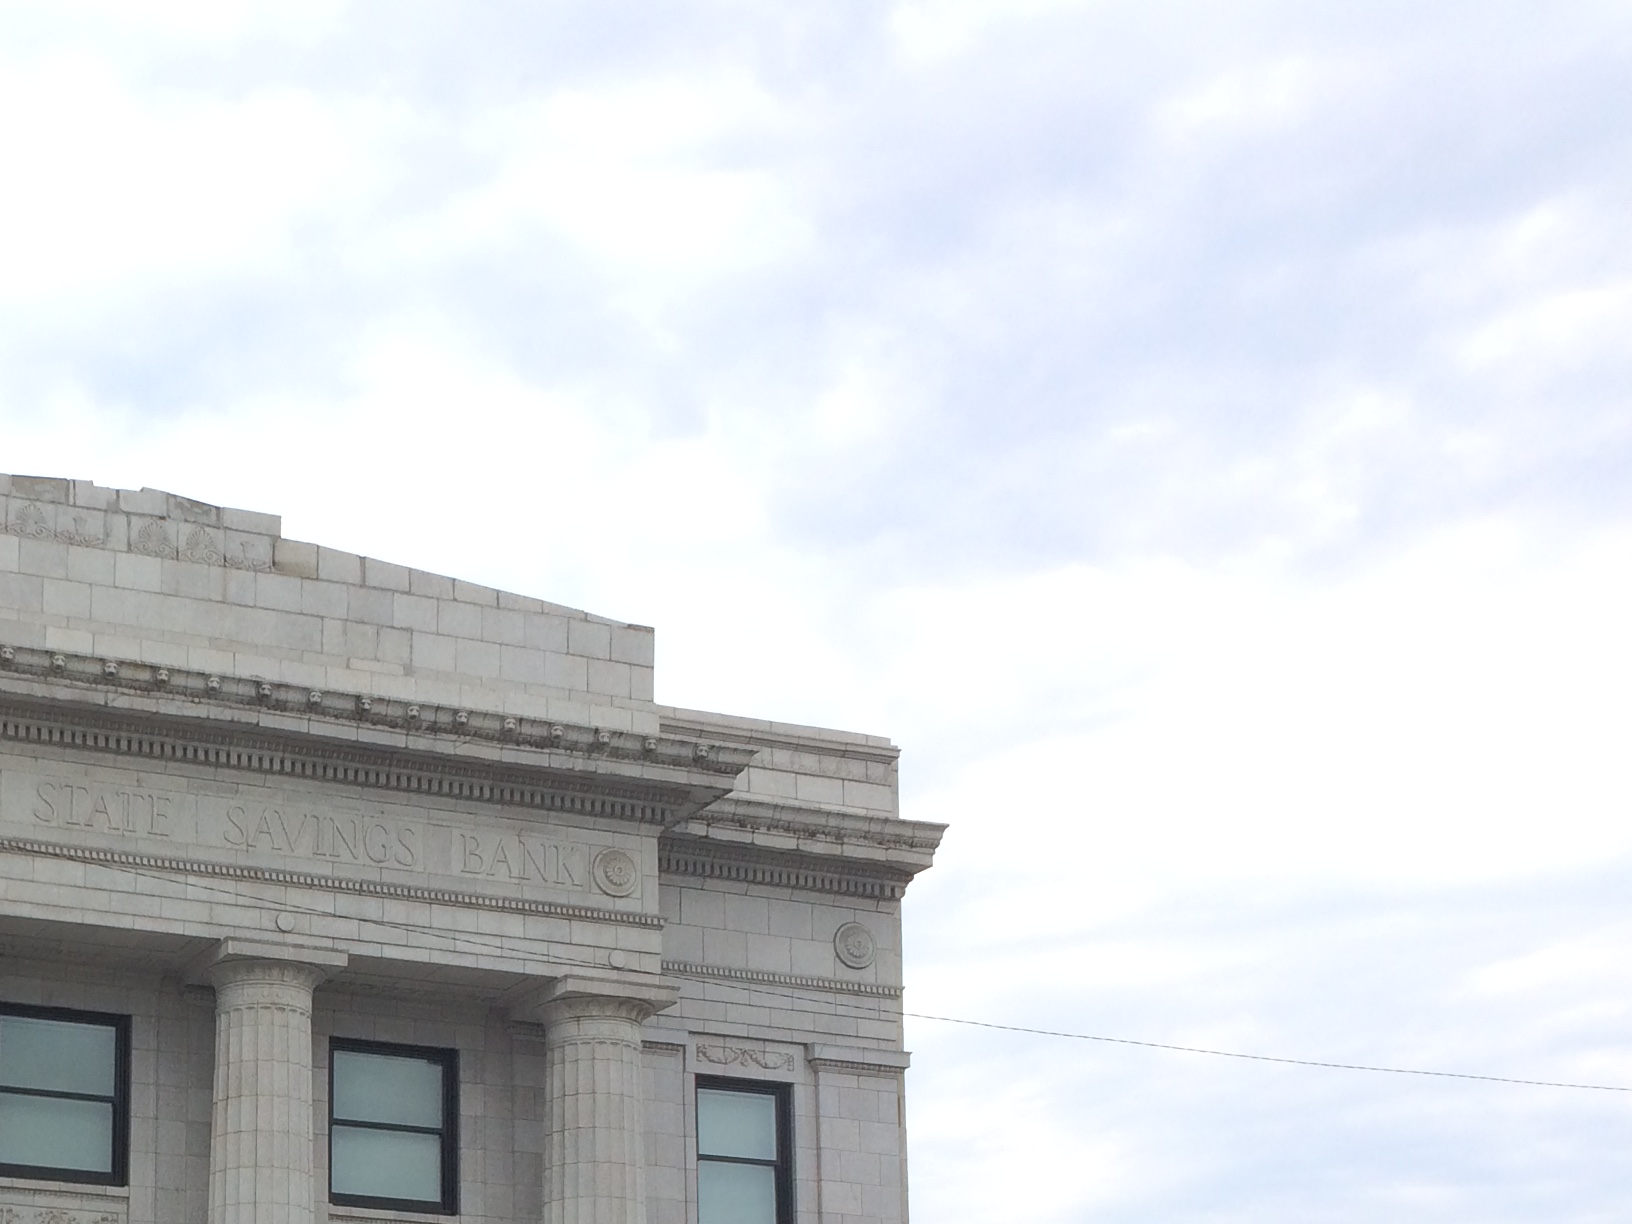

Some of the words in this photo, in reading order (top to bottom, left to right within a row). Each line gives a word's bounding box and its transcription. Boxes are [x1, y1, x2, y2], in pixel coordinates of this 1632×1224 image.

[32, 781, 173, 838] STATE
[222, 805, 417, 867] SAVINGS
[459, 833, 585, 888] BANK
